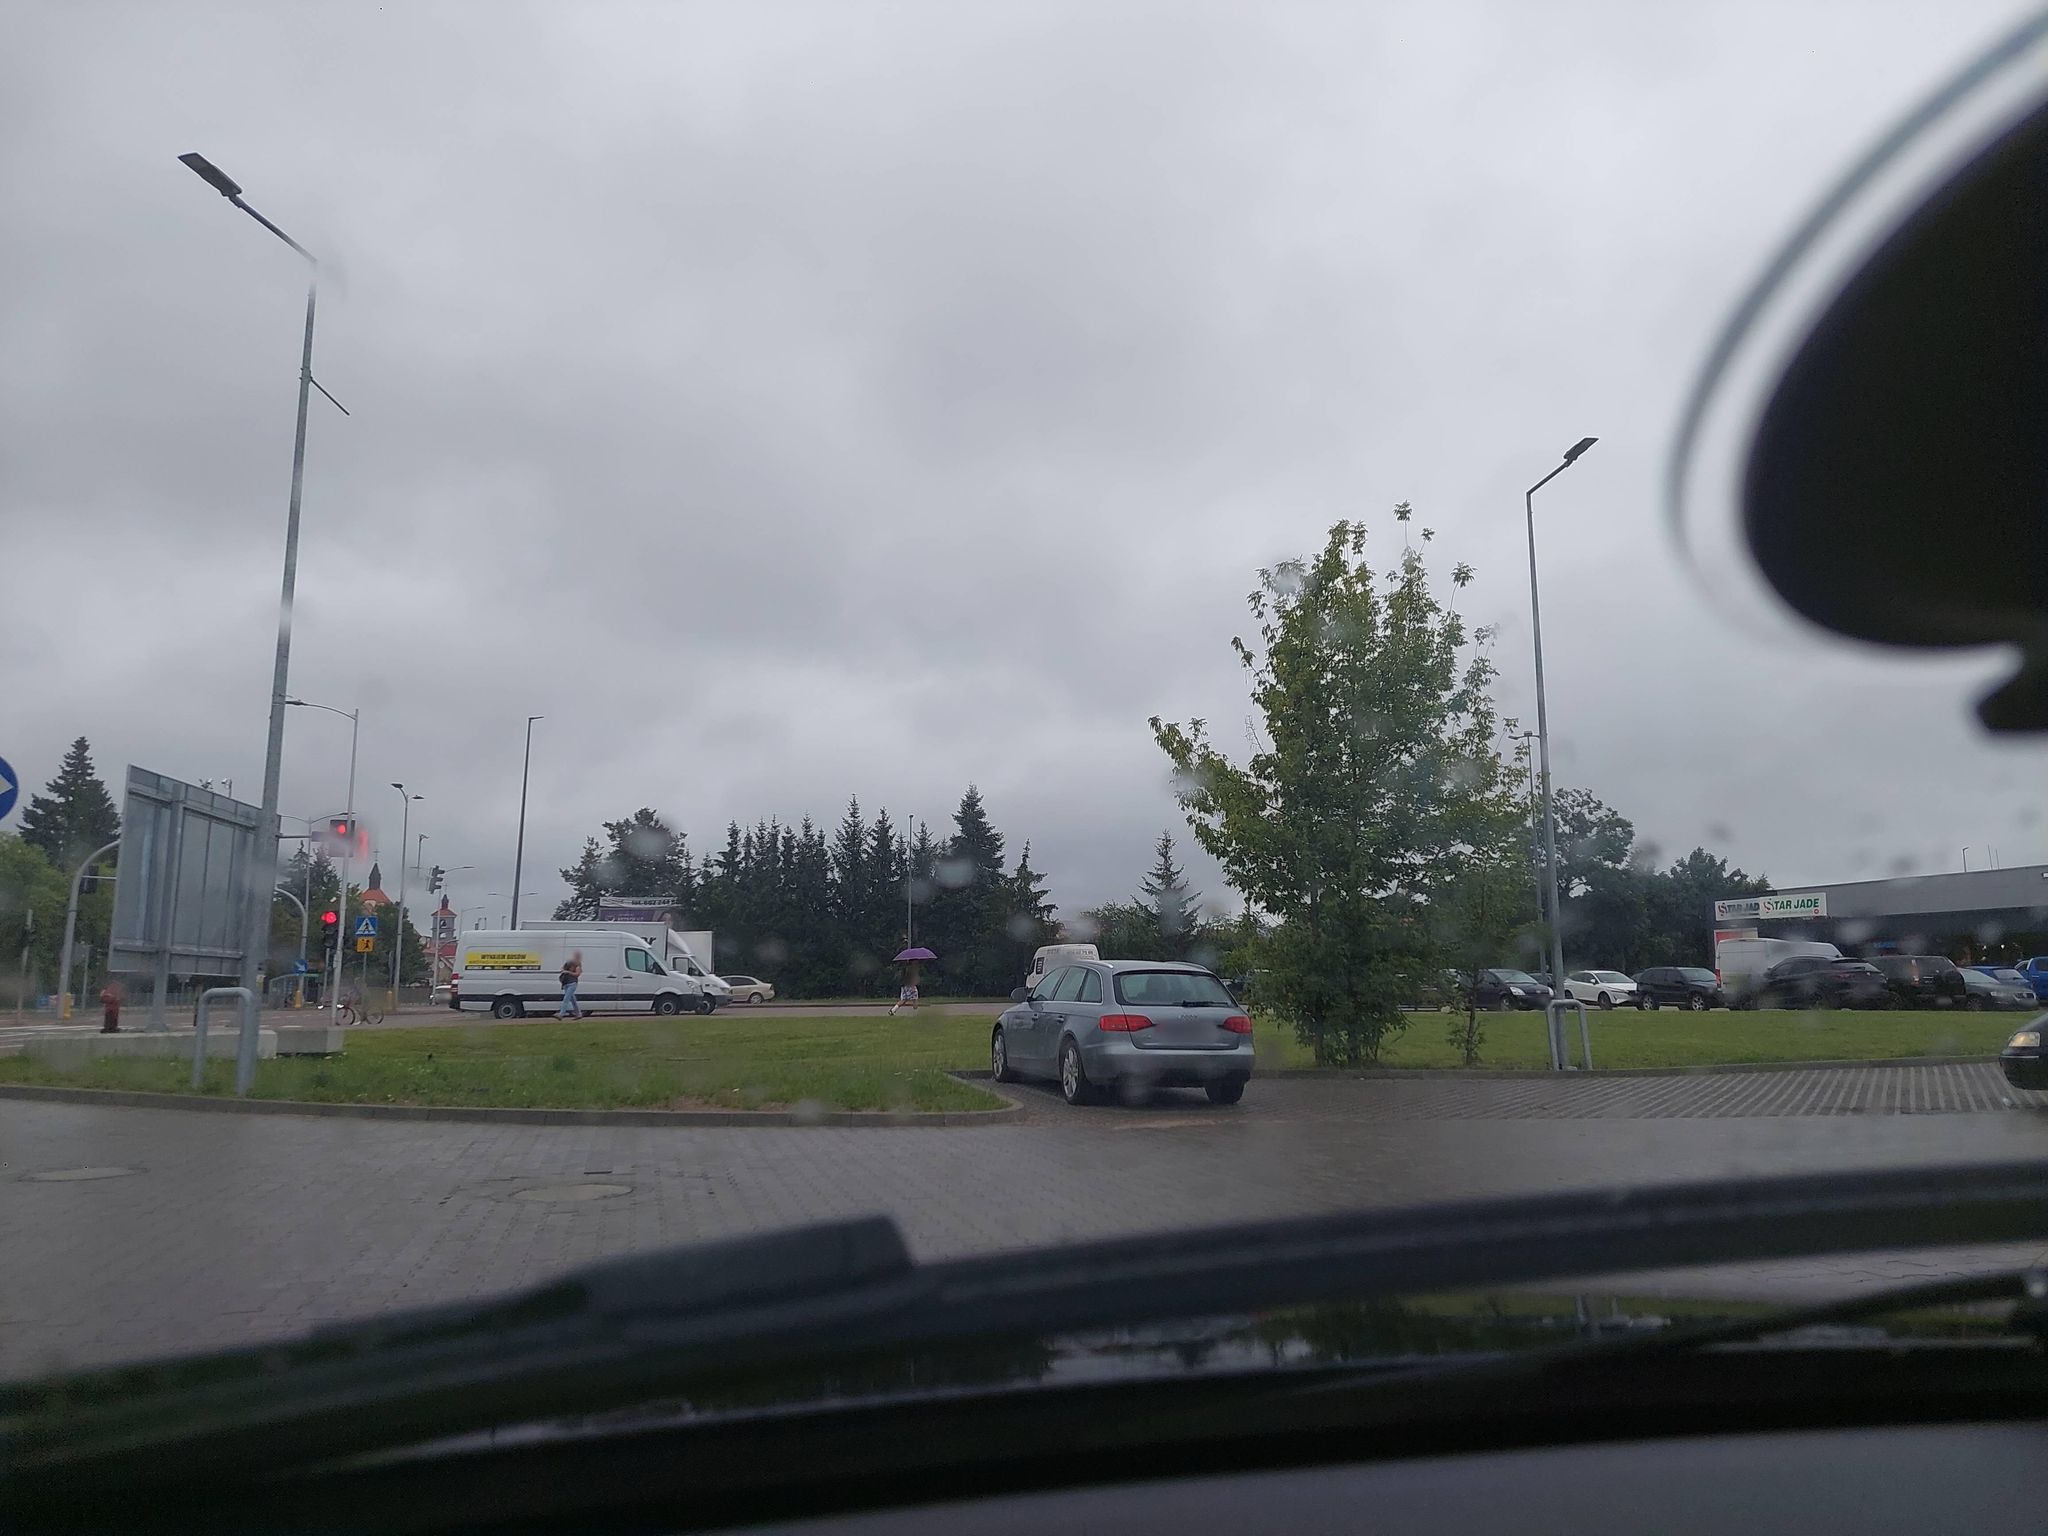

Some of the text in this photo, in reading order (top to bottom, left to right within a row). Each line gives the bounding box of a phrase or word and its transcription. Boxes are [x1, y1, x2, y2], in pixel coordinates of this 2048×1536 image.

[1744, 902, 1759, 912] JAD
[1764, 898, 1819, 914] STAR JADE
